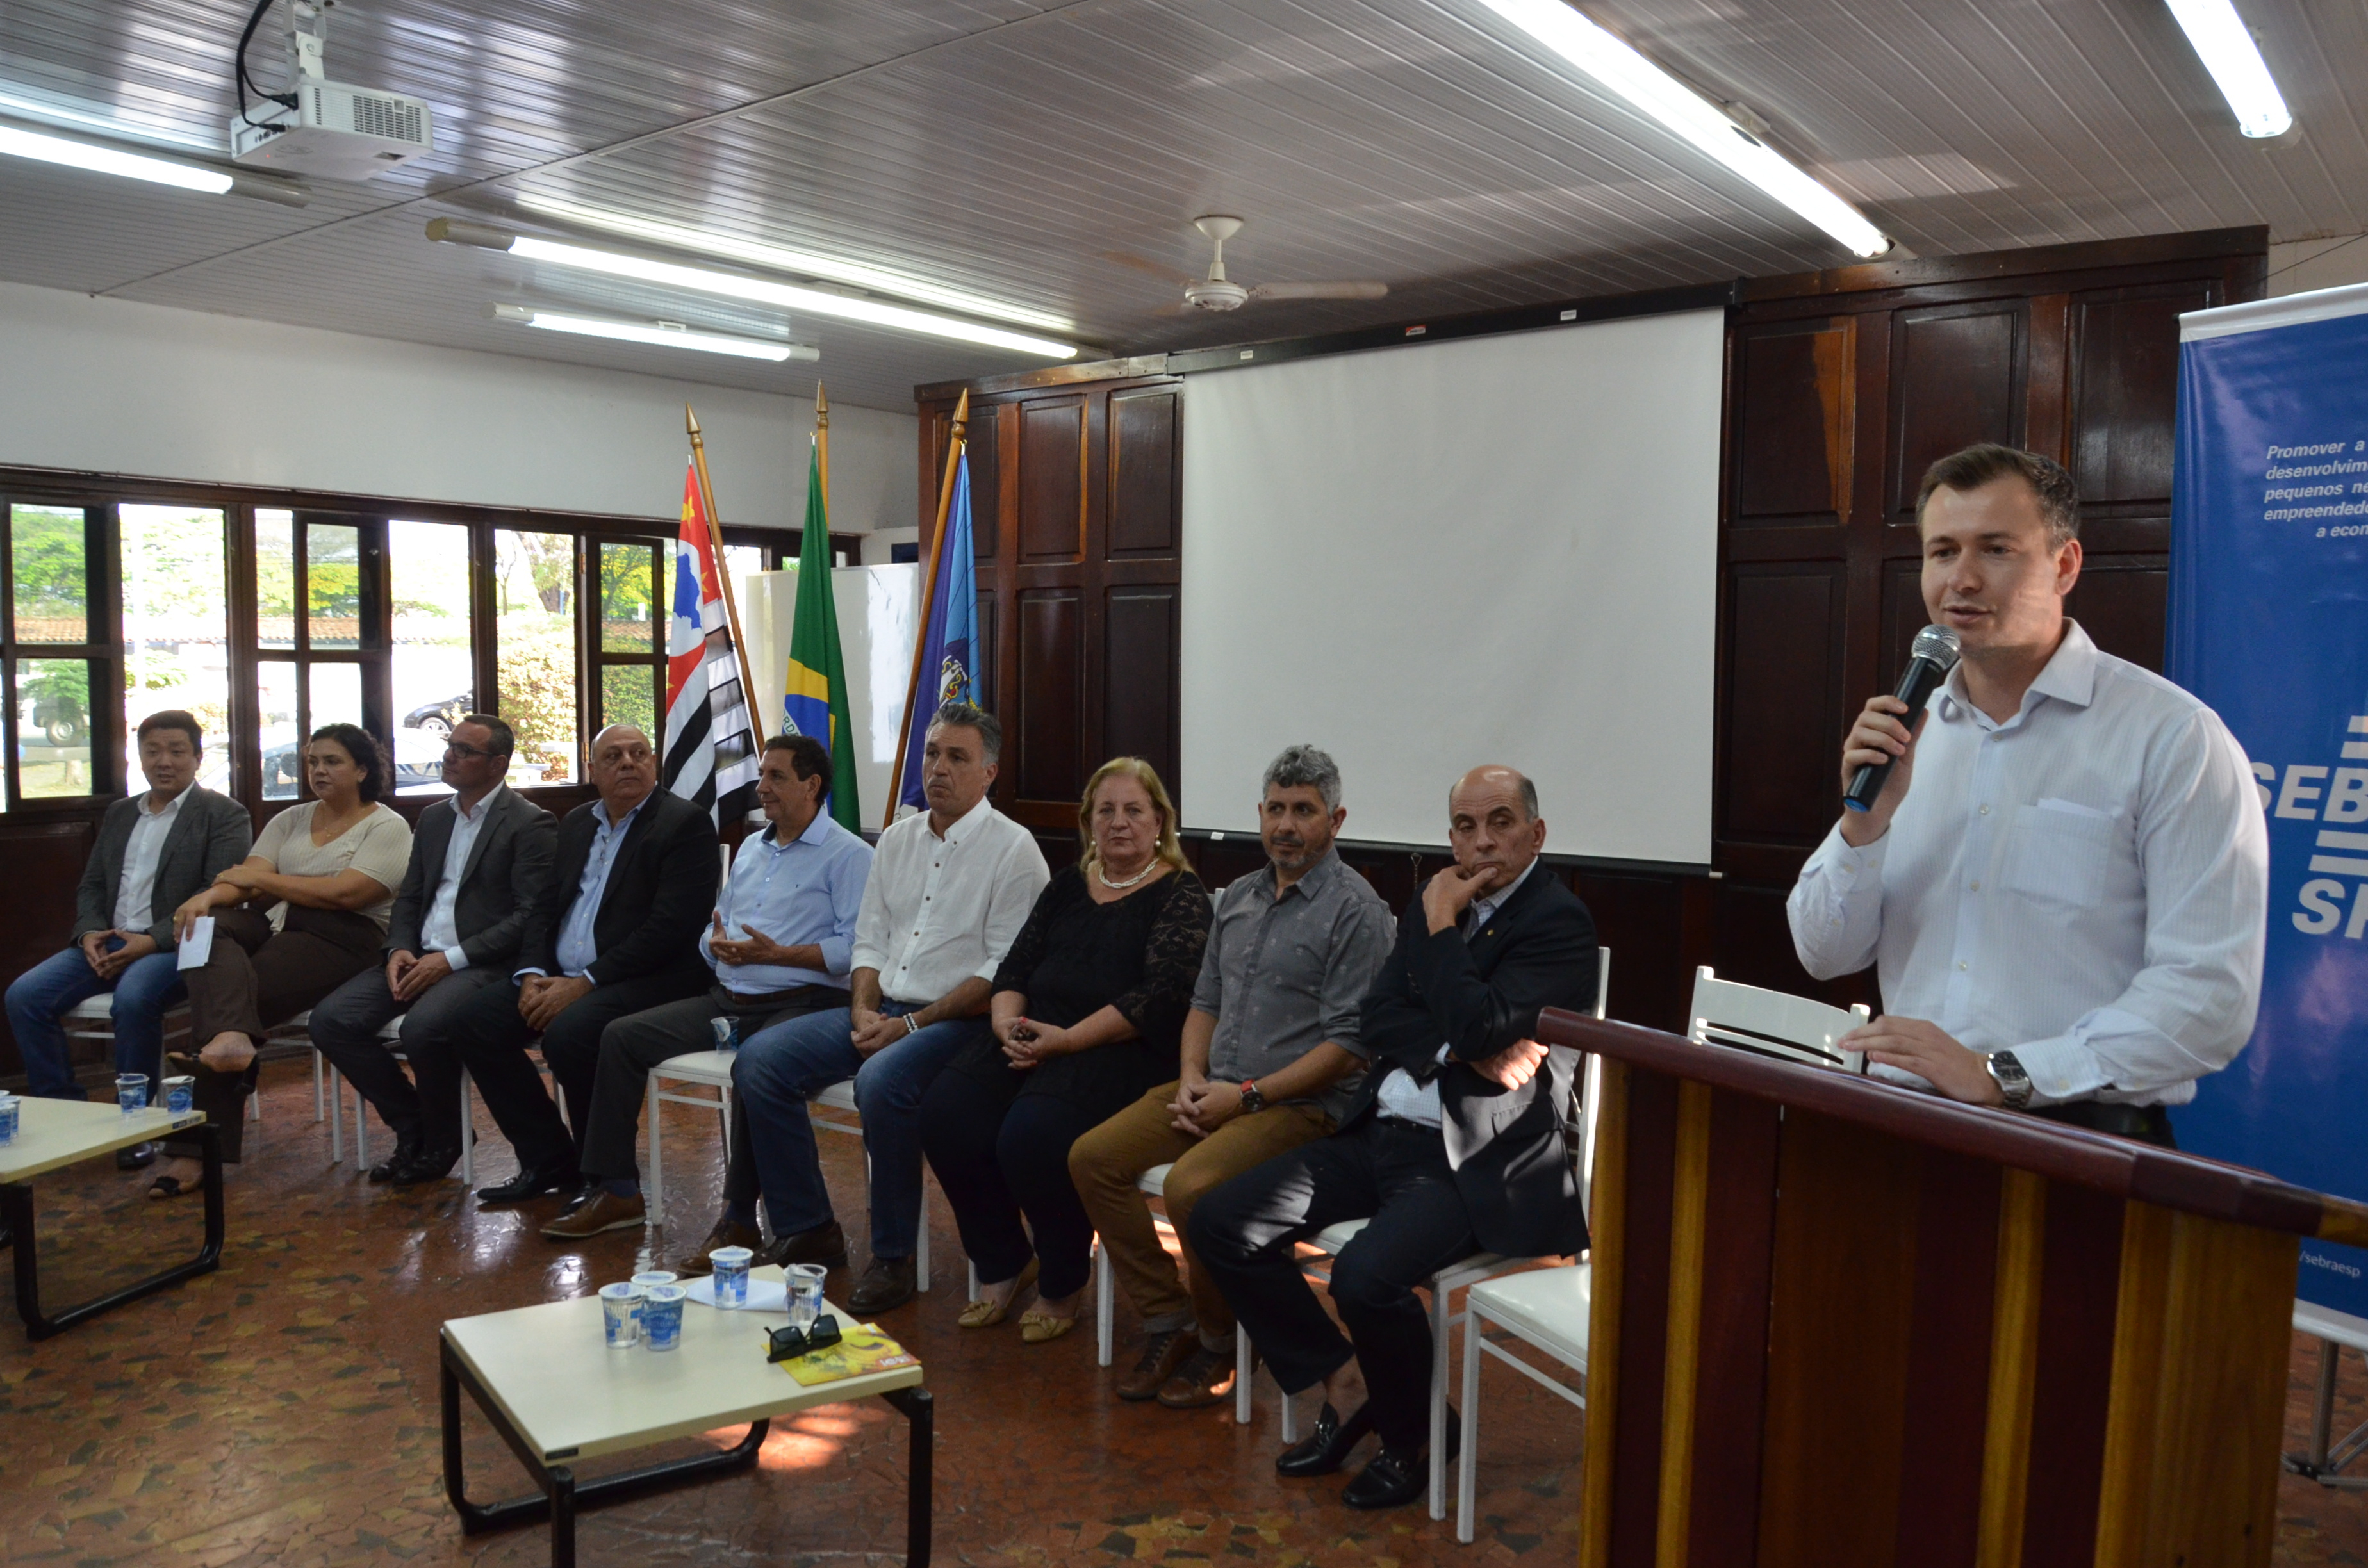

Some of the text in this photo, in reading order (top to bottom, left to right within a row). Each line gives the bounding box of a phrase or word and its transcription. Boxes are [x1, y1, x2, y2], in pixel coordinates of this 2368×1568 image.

[2266, 440, 2365, 459] Promover a
[2265, 459, 2368, 480] desenvolvim
[2264, 484, 2344, 503] pequenos
[2315, 527, 2326, 537] a
